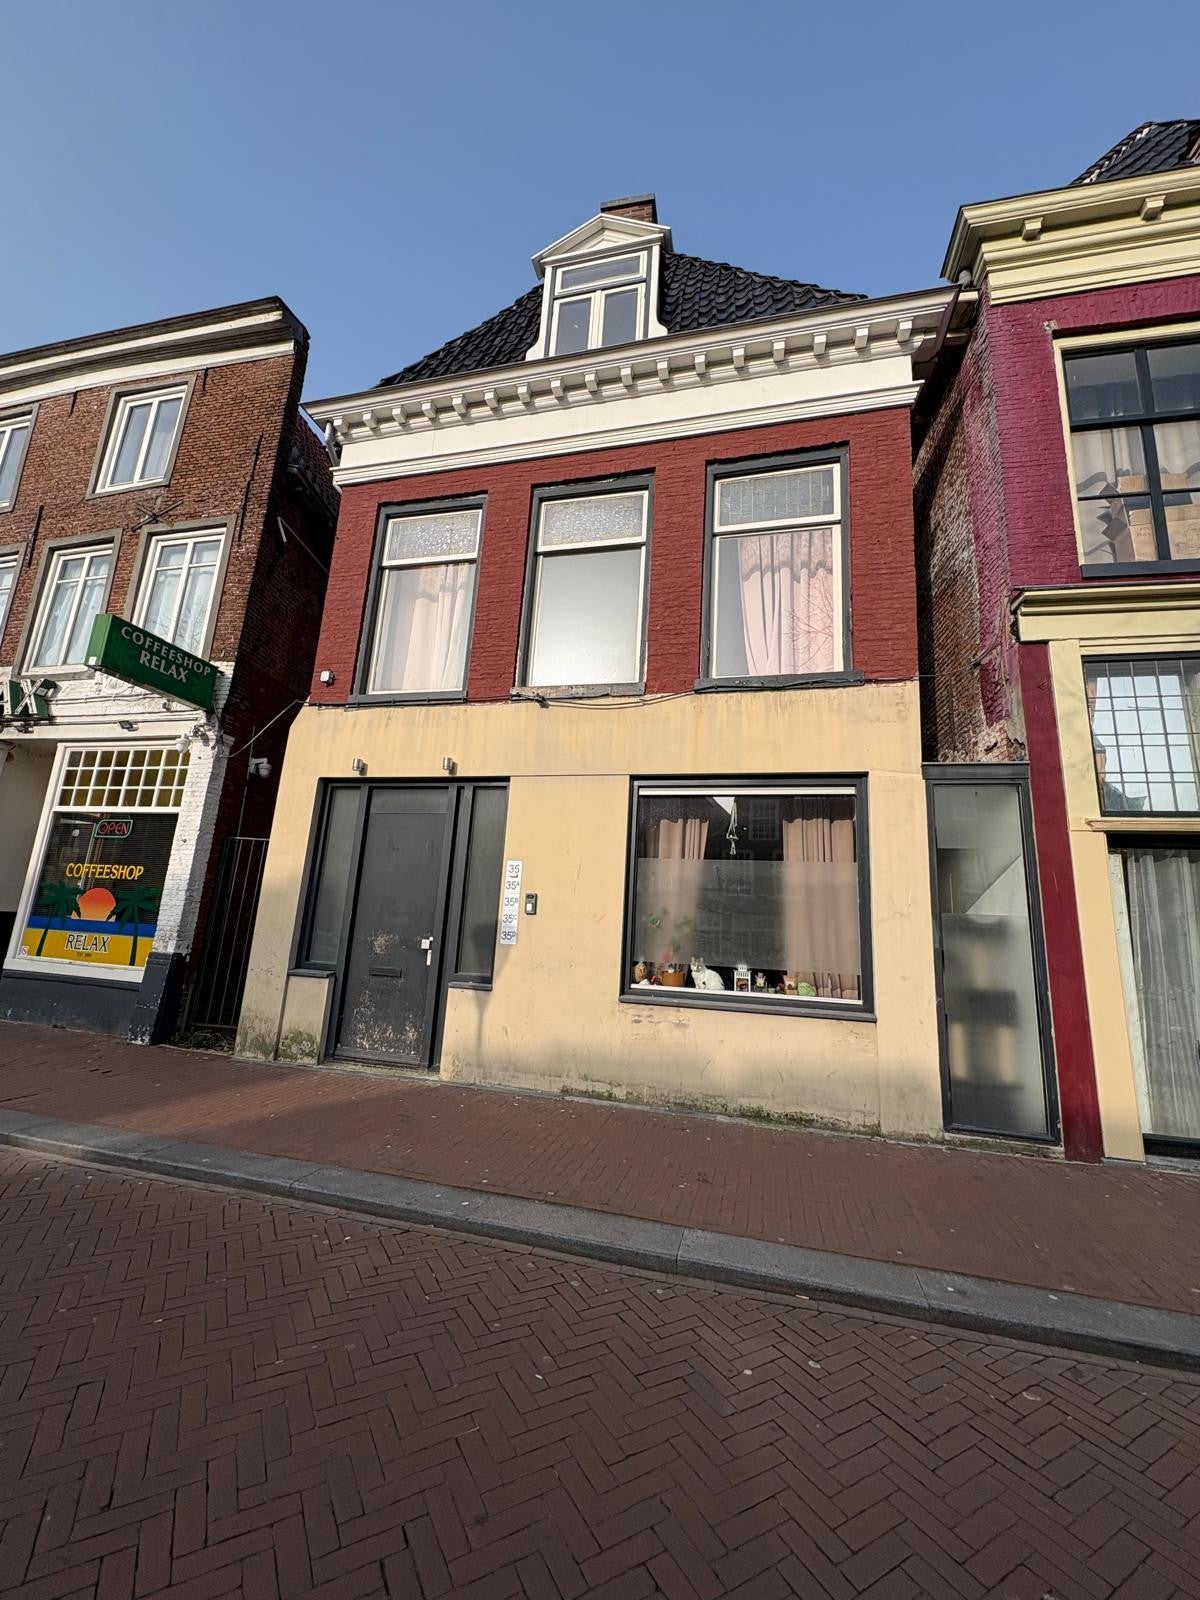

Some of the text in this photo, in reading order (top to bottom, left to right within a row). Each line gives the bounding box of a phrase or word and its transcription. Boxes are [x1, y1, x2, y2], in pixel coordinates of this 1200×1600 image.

[121, 626, 211, 676] COFFEESHOP
[140, 650, 189, 683] RELAX
[98, 822, 130, 835] OPEN
[65, 862, 145, 881] COFFEESHOP
[508, 864, 520, 874] 35
[65, 933, 110, 953] RELAX
